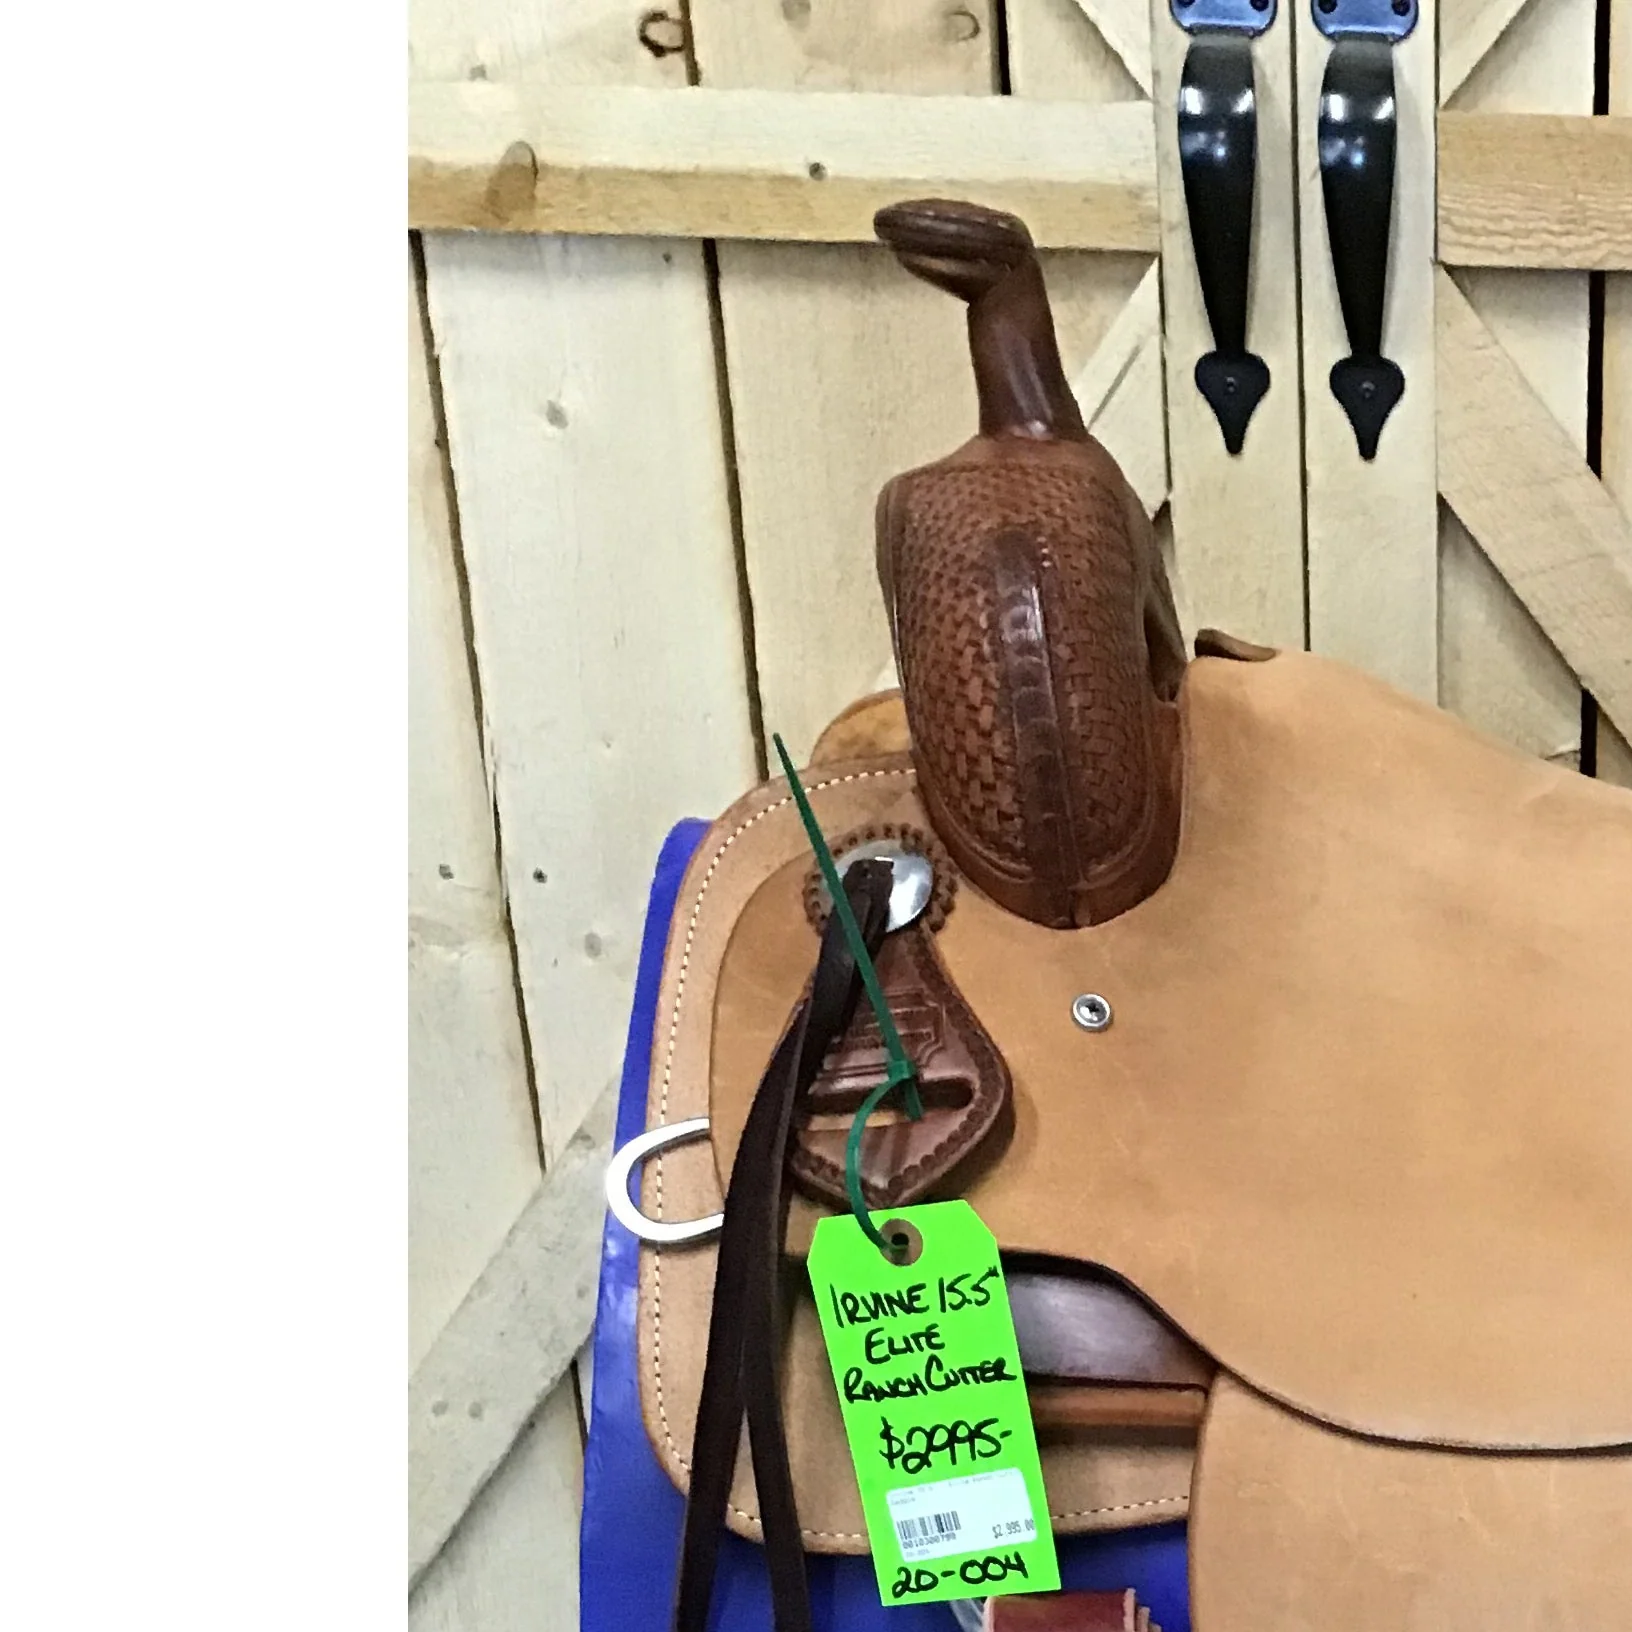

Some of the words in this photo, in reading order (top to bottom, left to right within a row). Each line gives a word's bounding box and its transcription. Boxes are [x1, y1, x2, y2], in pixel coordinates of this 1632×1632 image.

[829, 1282, 930, 1329] IRVINE
[864, 1322, 946, 1365] ELITE
[891, 1550, 1029, 1599] 20-004
